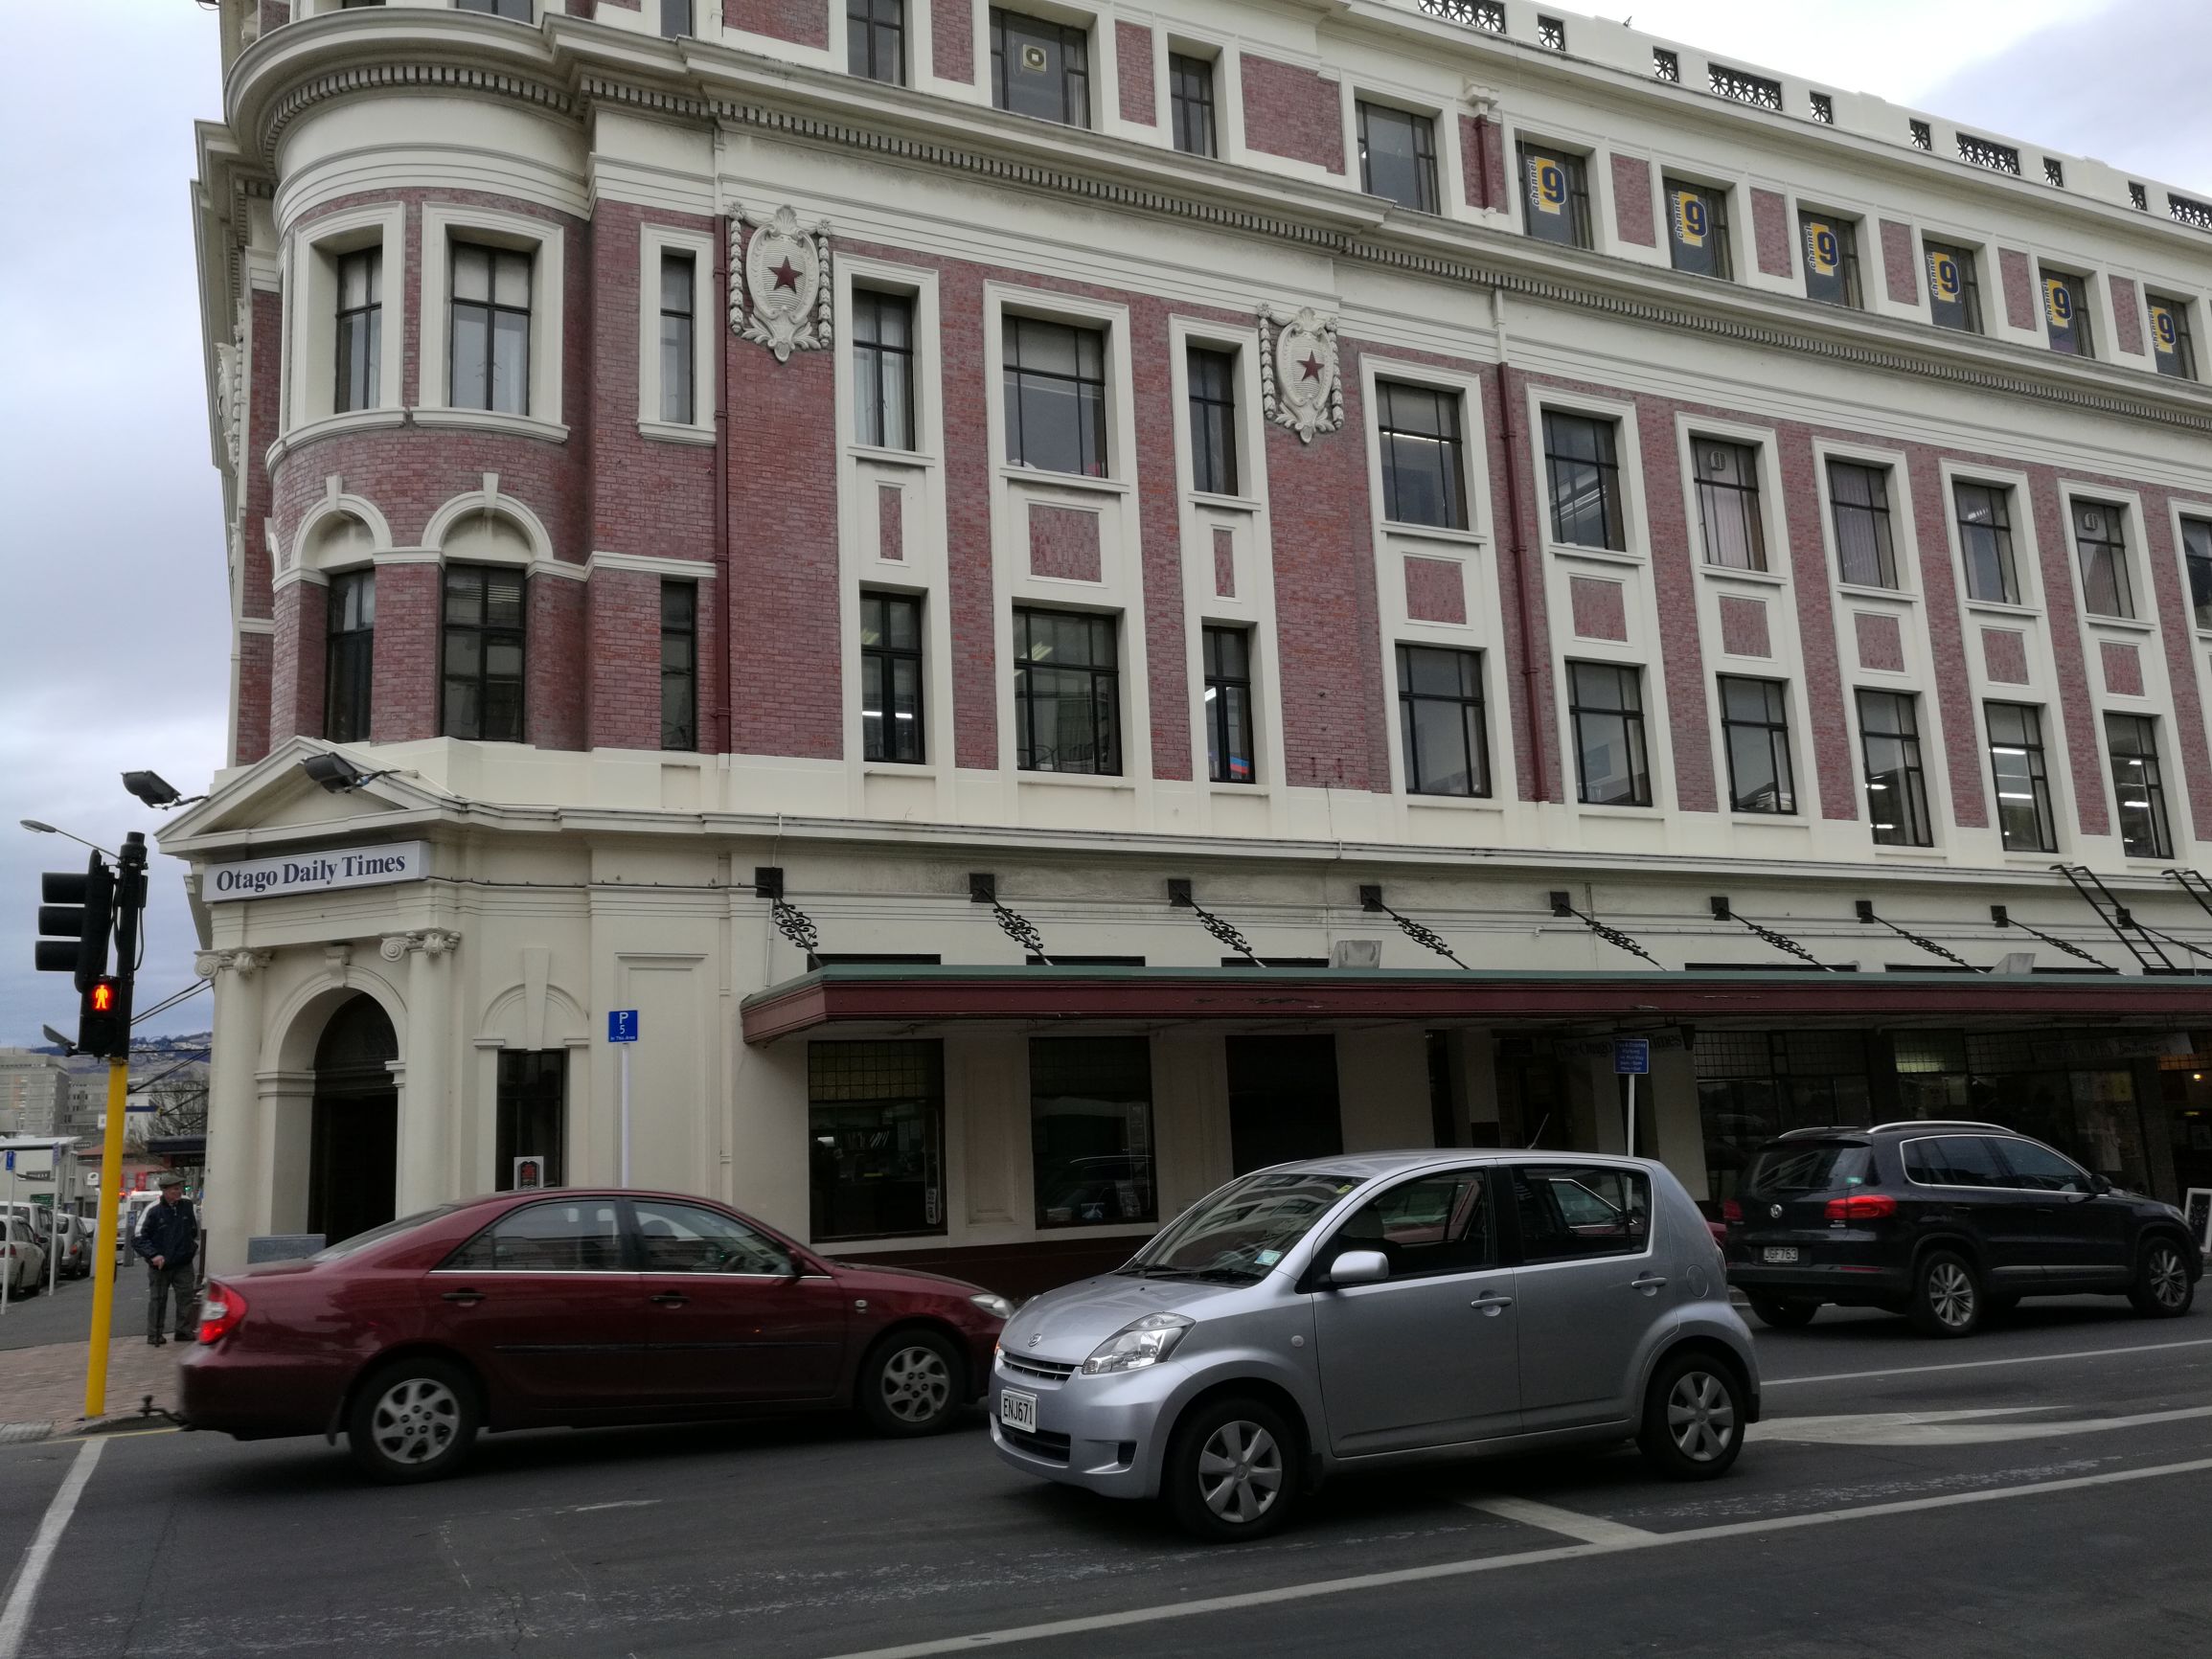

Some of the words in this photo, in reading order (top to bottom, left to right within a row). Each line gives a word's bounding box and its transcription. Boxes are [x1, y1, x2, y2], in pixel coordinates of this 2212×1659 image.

[1528, 159, 1540, 206] channel
[1541, 167, 1565, 204] 9
[1671, 194, 1684, 239] channel
[1684, 200, 1707, 237] 9
[1804, 225, 1816, 270] channel
[1816, 231, 1838, 266] 9
[1927, 253, 1939, 297] channel
[1939, 261, 1960, 295] 9
[2041, 280, 2053, 322] channel
[2053, 286, 2073, 321] 9
[2157, 312, 2176, 345] 9
[217, 869, 278, 893] Otago
[283, 859, 337, 885] Daily
[342, 854, 405, 877] Times
[619, 1011, 628, 1024] P
[620, 1024, 626, 1034] 5
[1003, 1398, 1034, 1425] ENJ671
